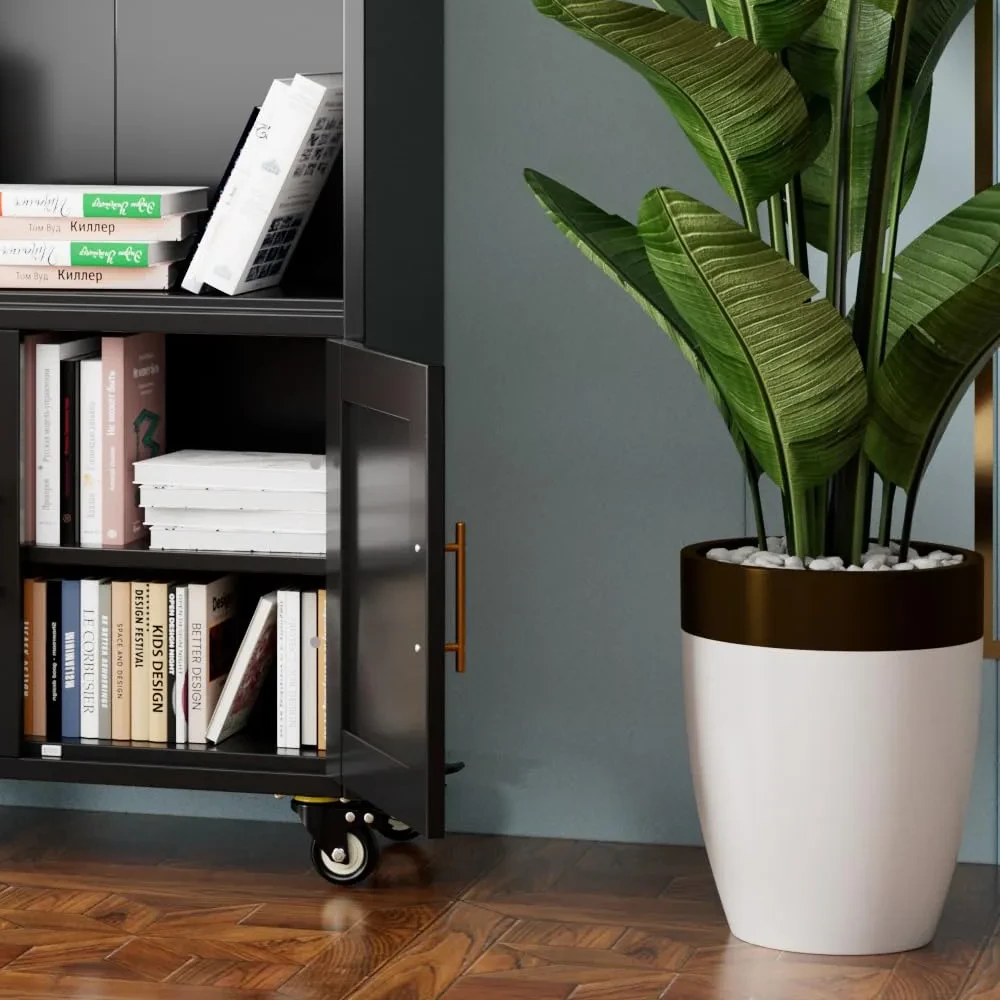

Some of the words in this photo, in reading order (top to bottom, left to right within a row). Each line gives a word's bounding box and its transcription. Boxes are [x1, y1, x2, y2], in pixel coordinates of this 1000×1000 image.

[29, 223, 46, 233] Том
[47, 223, 61, 234] Вуд
[70, 221, 116, 234] Киллер
[16, 271, 34, 280] Том
[35, 271, 49, 282] Вуд
[57, 269, 103, 282] Киллер
[82, 609, 95, 626] LE
[134, 589, 144, 624] DESIGN
[116, 623, 124, 648] SPACE
[134, 627, 144, 669] FESTIVAL
[152, 624, 164, 657] KIDS
[191, 622, 202, 664] BETTER
[82, 630, 95, 714] CORBUSIER
[116, 650, 124, 667] AND
[116, 669, 124, 700] DESIGN
[152, 660, 164, 714] DESIGN
[191, 667, 202, 711] DESIGN
